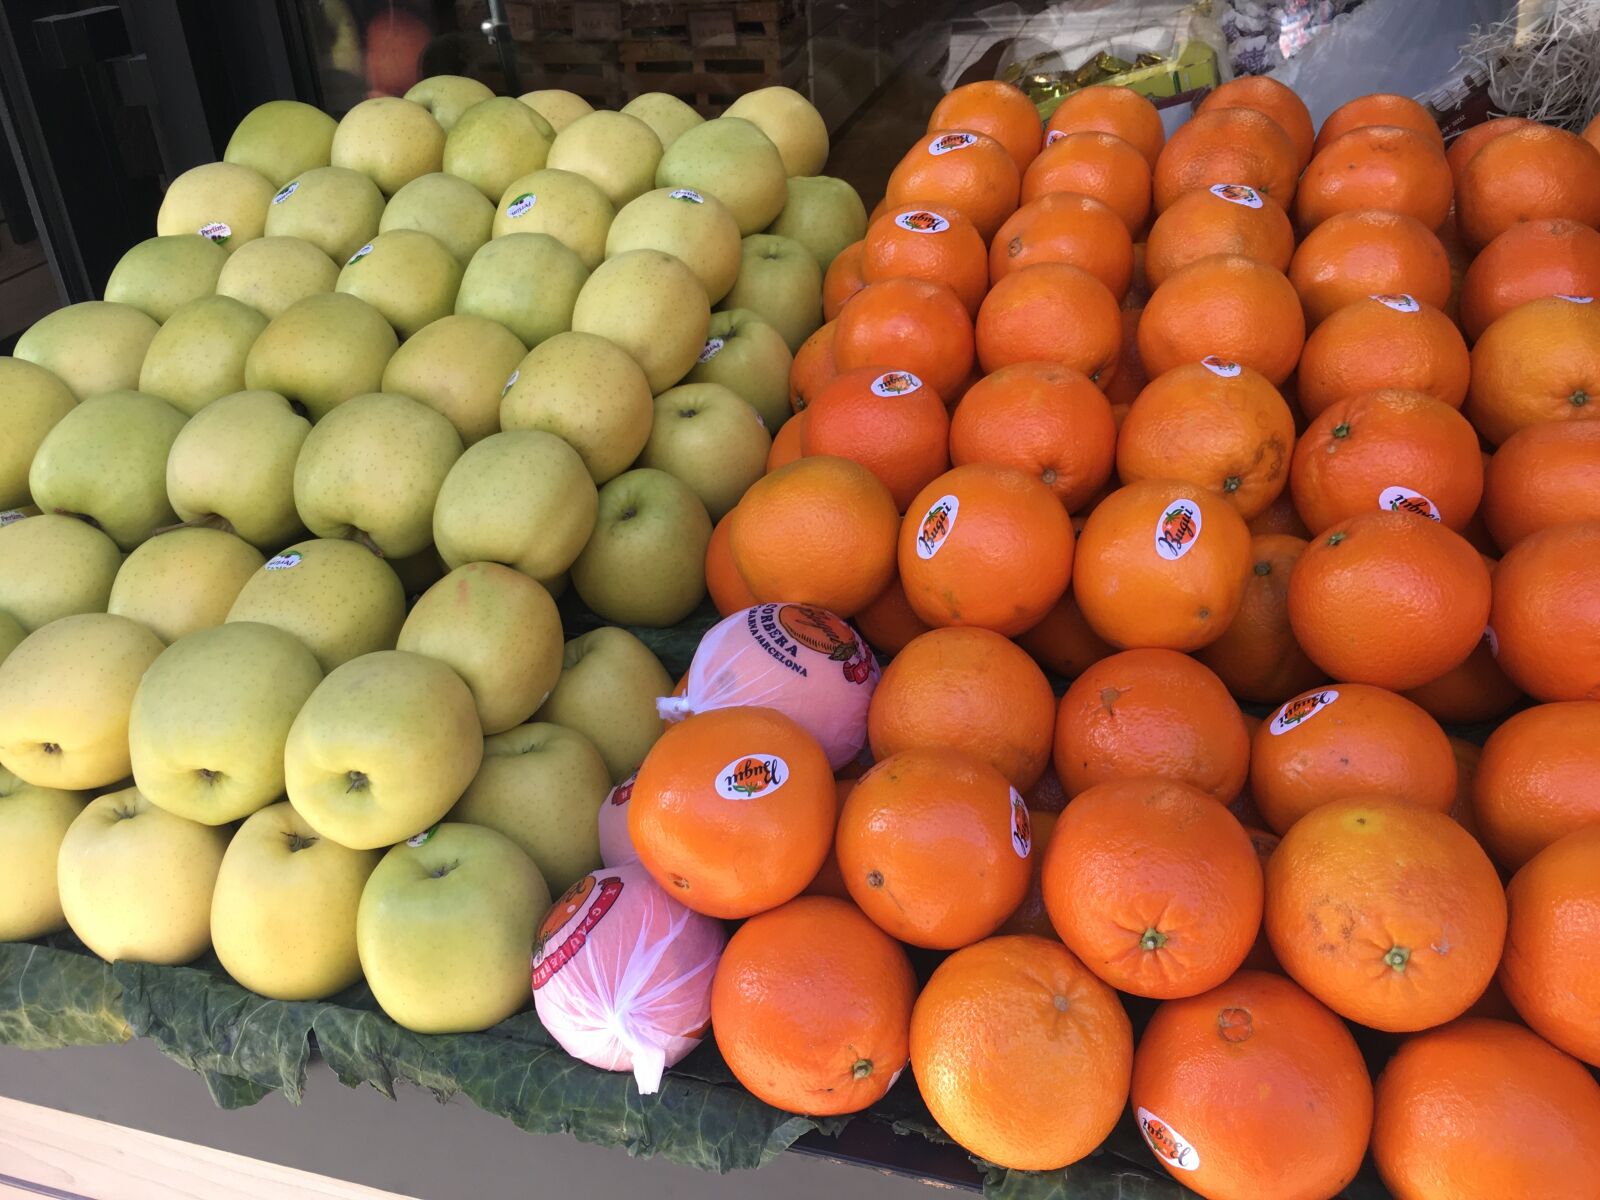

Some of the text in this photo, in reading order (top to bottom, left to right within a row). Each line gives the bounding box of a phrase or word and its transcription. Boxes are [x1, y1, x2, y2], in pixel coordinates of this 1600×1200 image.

[918, 502, 952, 555] Bugui
[1158, 505, 1193, 557] Bugui
[755, 634, 808, 678] BARCELONA
[724, 758, 782, 792] Bugui
